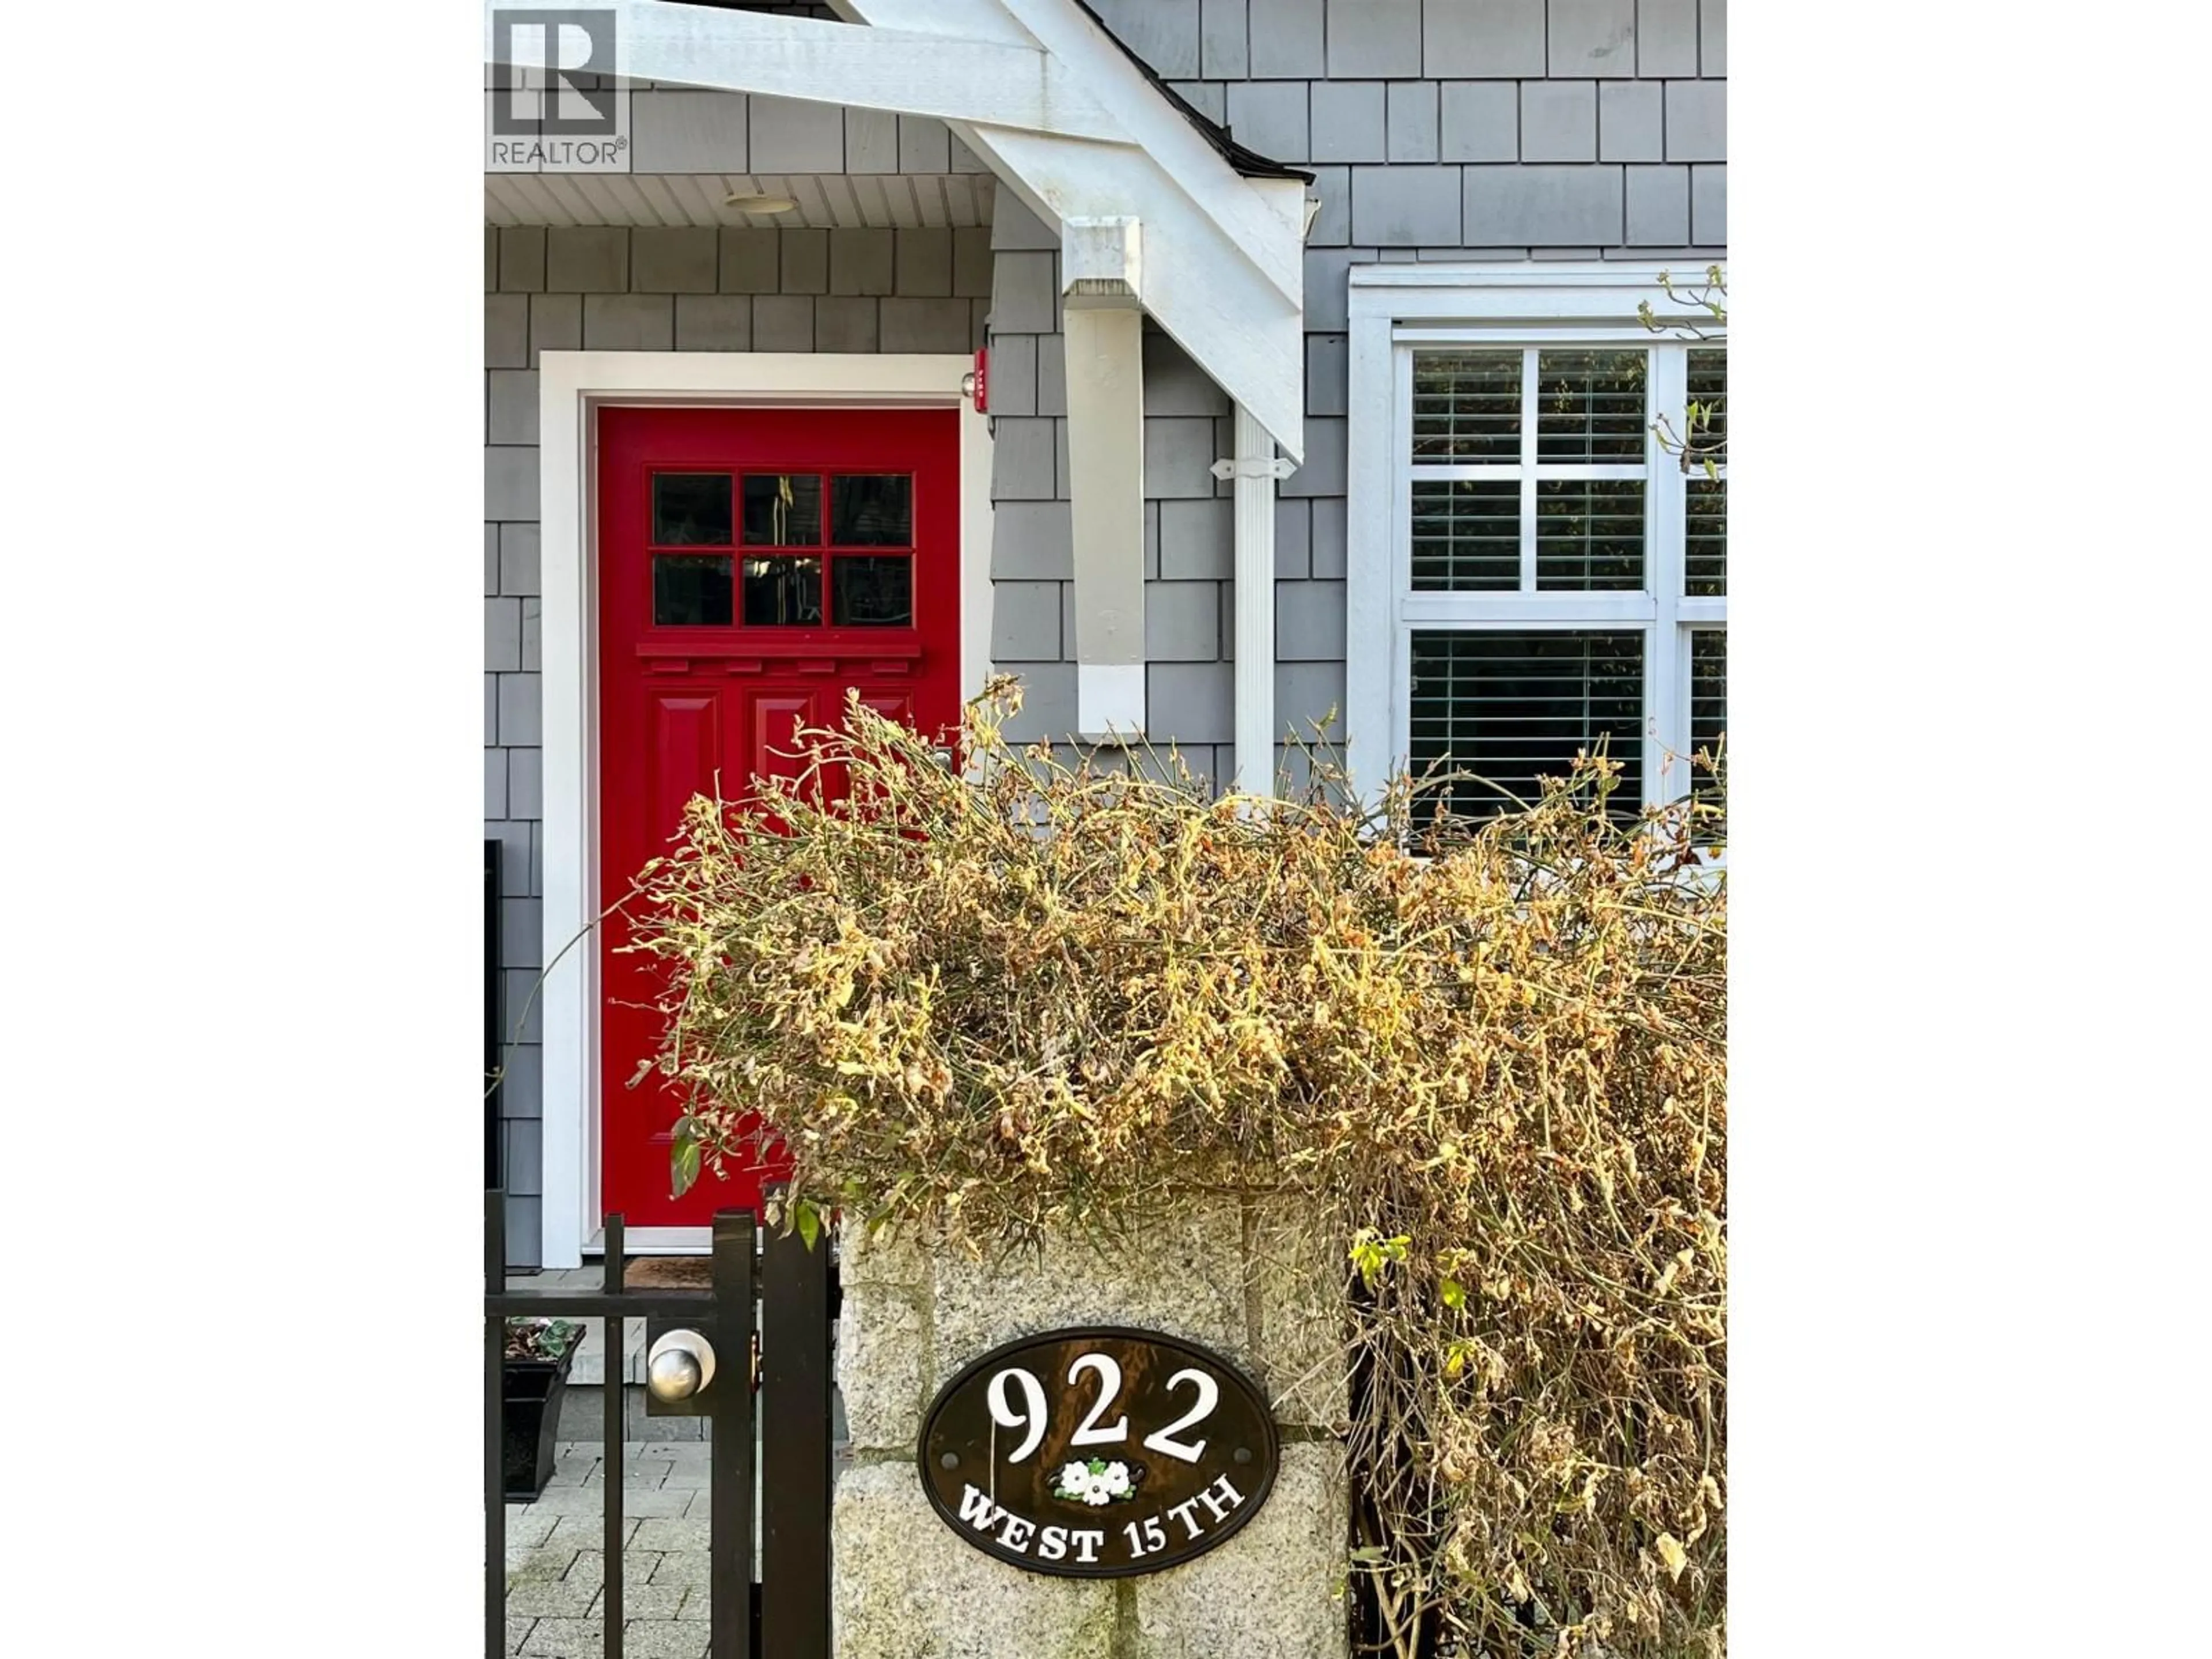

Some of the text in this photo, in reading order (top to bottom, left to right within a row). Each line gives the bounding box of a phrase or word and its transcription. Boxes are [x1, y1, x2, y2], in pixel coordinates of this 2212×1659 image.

[987, 1354, 1218, 1463] 922
[957, 1473, 1245, 1562] WEST 15TH
